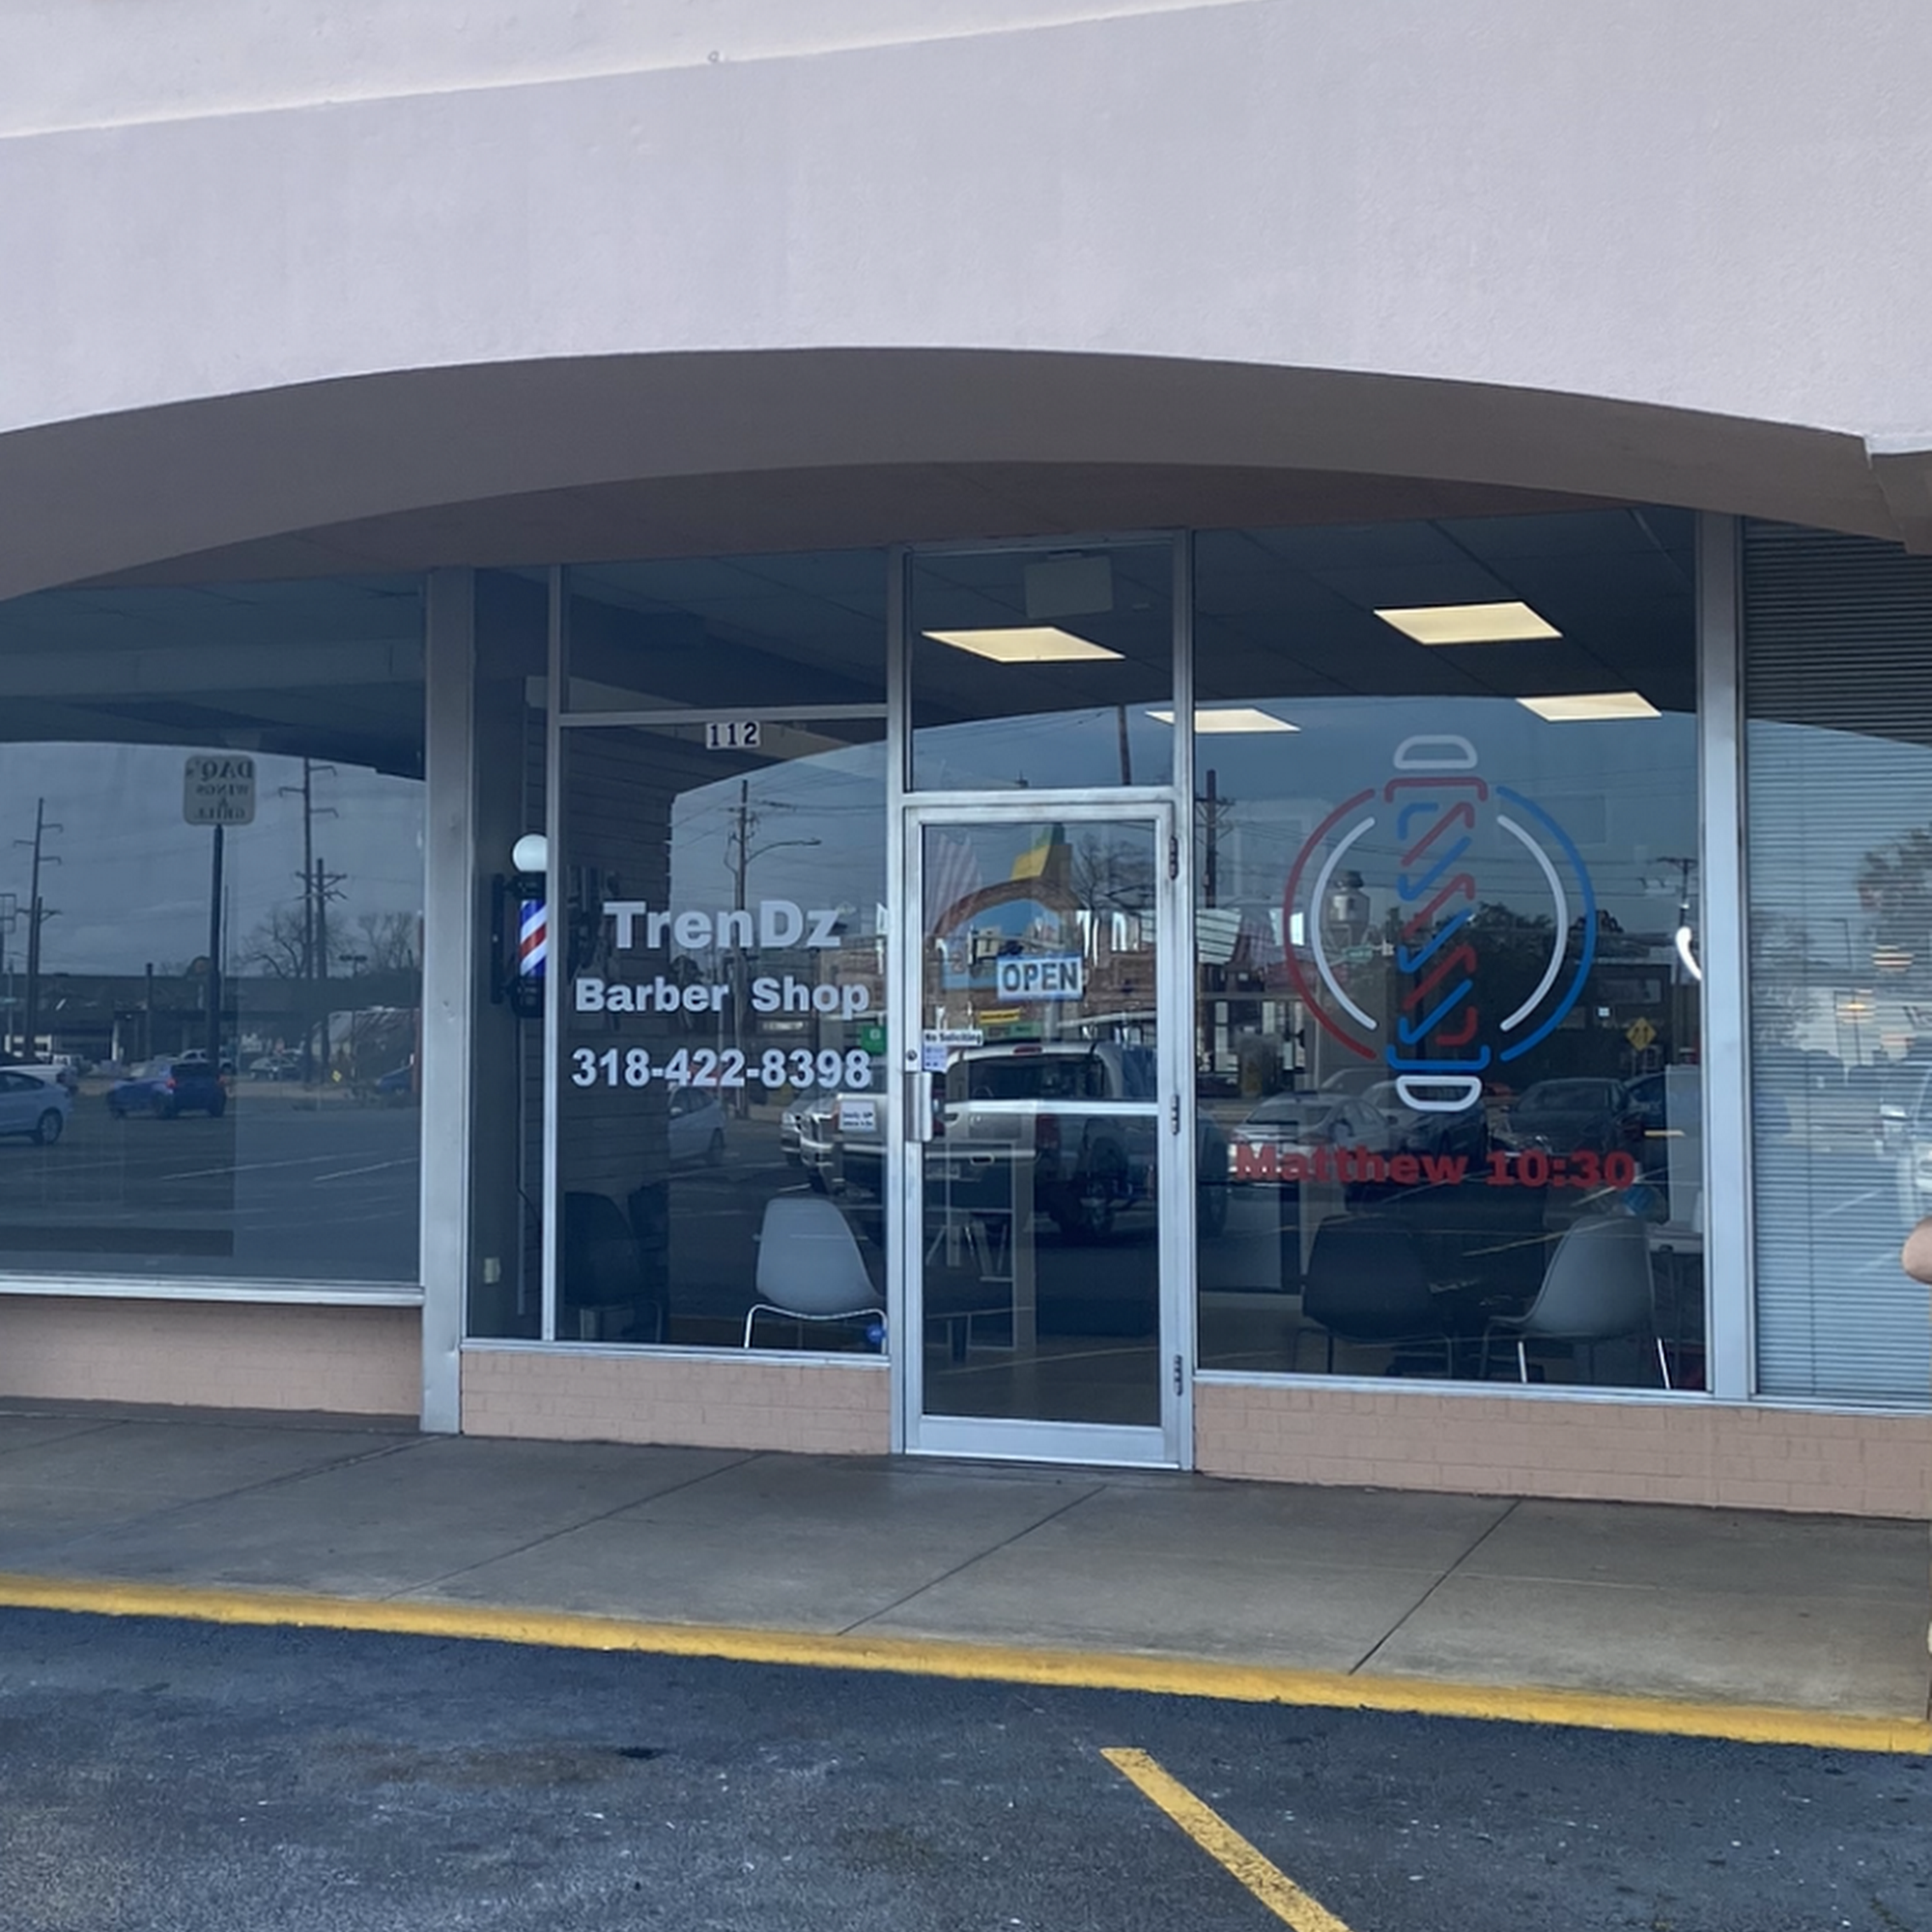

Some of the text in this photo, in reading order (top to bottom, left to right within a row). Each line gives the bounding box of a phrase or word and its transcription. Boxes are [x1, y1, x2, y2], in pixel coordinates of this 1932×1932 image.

[710, 722, 757, 747] 112
[603, 899, 840, 949] TrenDz
[1002, 962, 1078, 992] OPEN
[575, 977, 869, 1020] Barber Shop
[572, 1047, 870, 1089] 318-422-8398
[1236, 1144, 1636, 1189] Matthew 10:30
